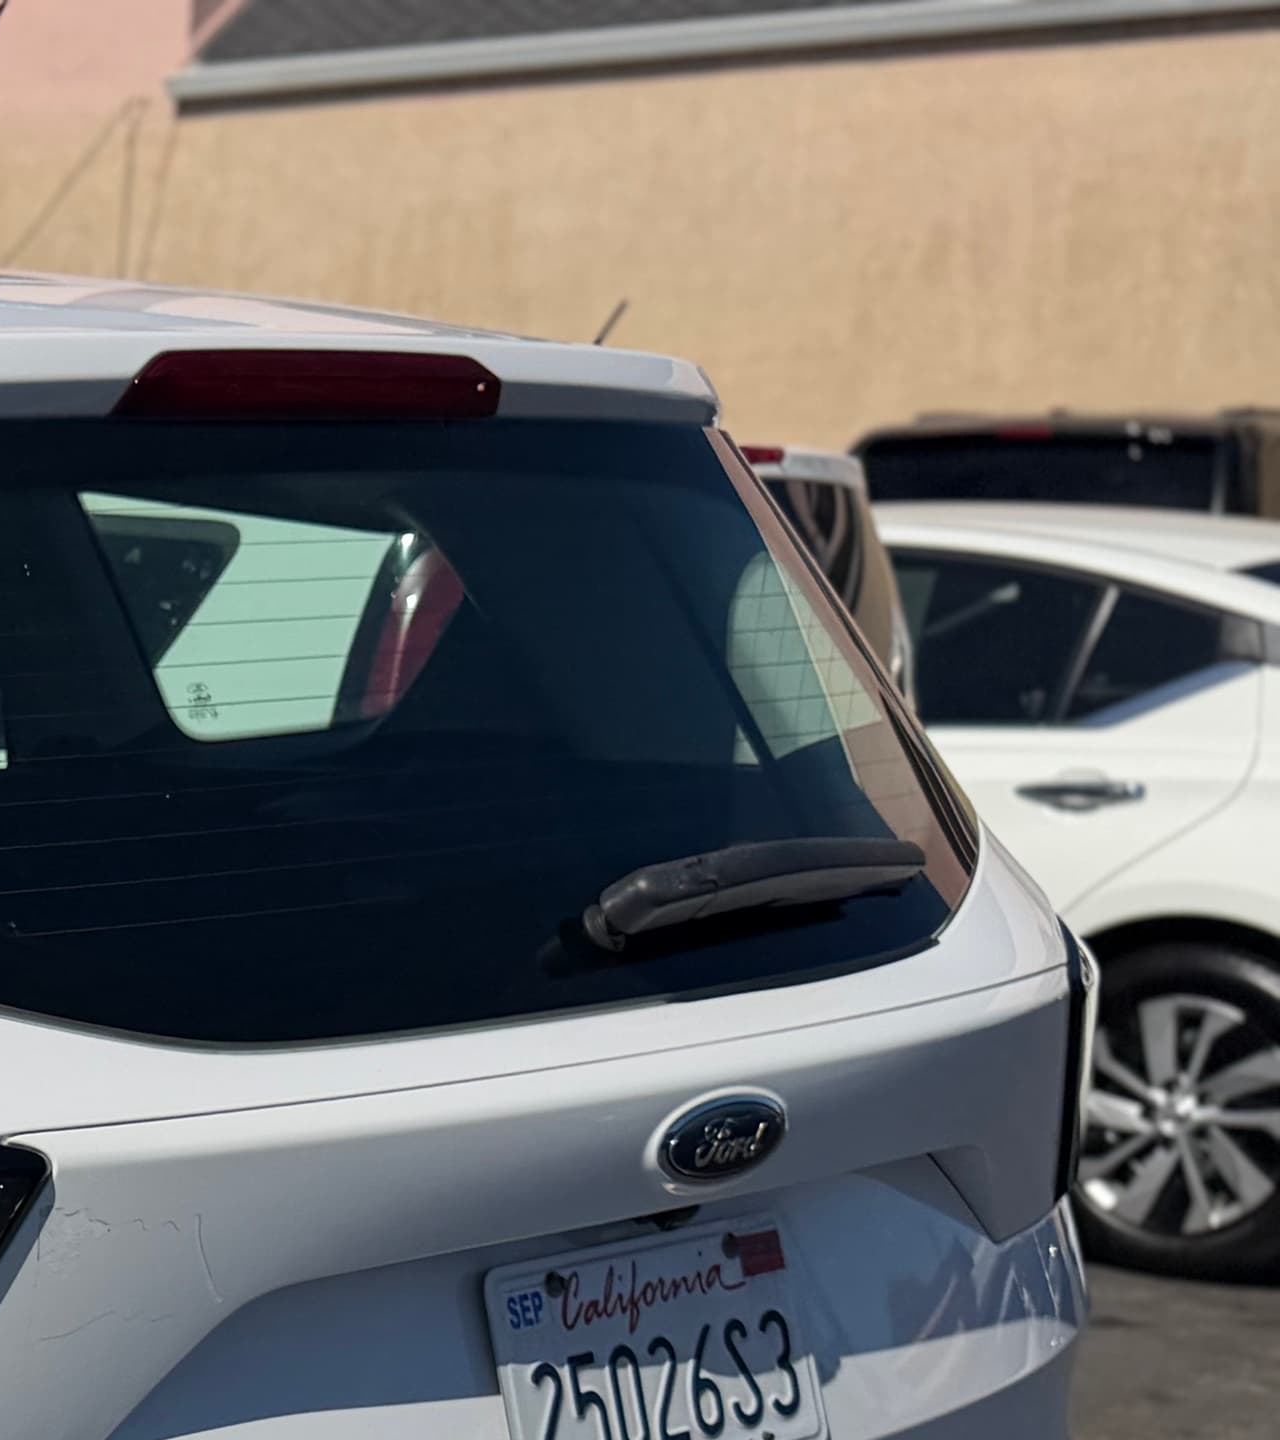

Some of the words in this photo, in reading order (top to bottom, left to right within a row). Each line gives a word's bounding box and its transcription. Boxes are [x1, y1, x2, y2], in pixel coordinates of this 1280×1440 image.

[695, 1117, 768, 1169] Ford
[506, 1290, 543, 1331] SEP
[559, 1251, 747, 1335] California
